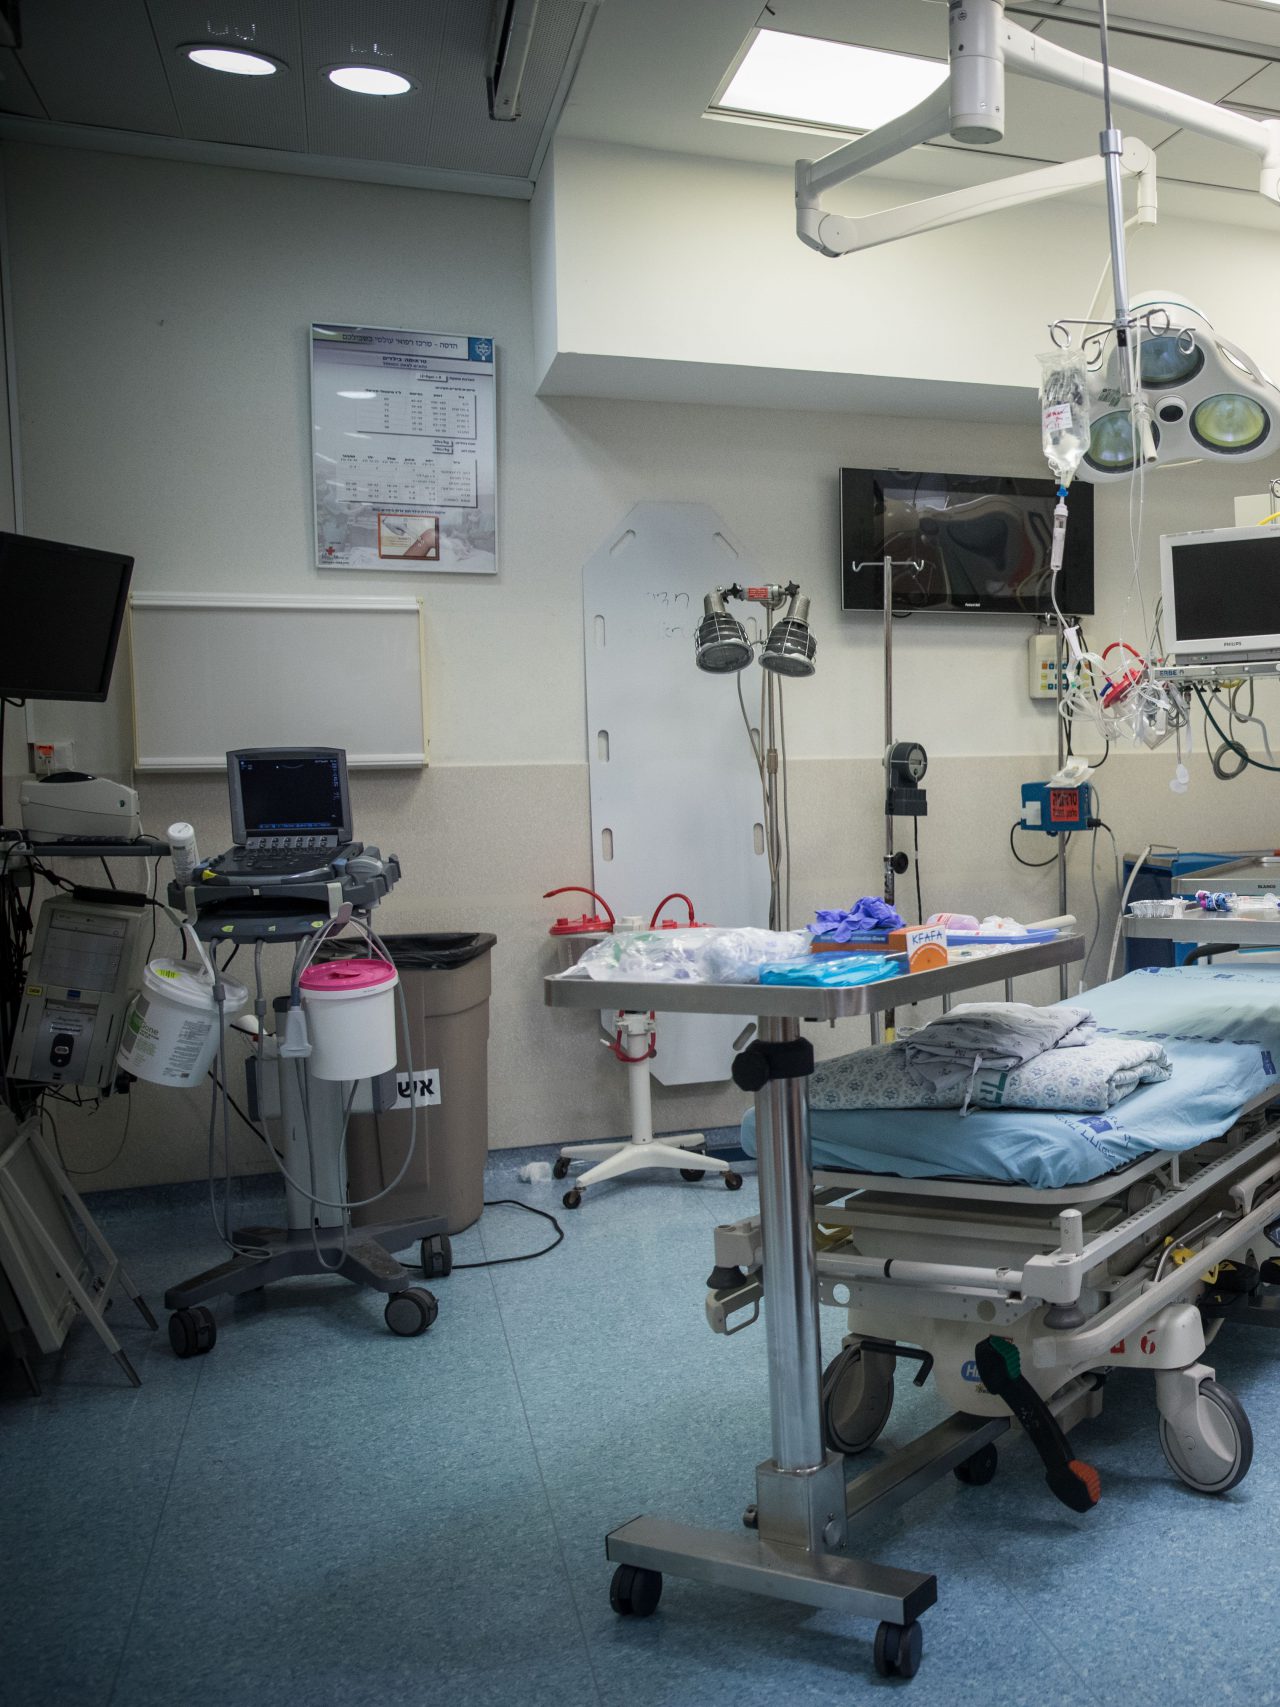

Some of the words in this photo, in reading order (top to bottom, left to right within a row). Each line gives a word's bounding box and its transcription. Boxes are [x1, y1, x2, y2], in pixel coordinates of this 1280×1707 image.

[395, 338, 414, 346] רפואי
[1159, 669, 1177, 677] ERBE
[911, 930, 943, 945] KFAFA
[1140, 1329, 1156, 1355] 6
